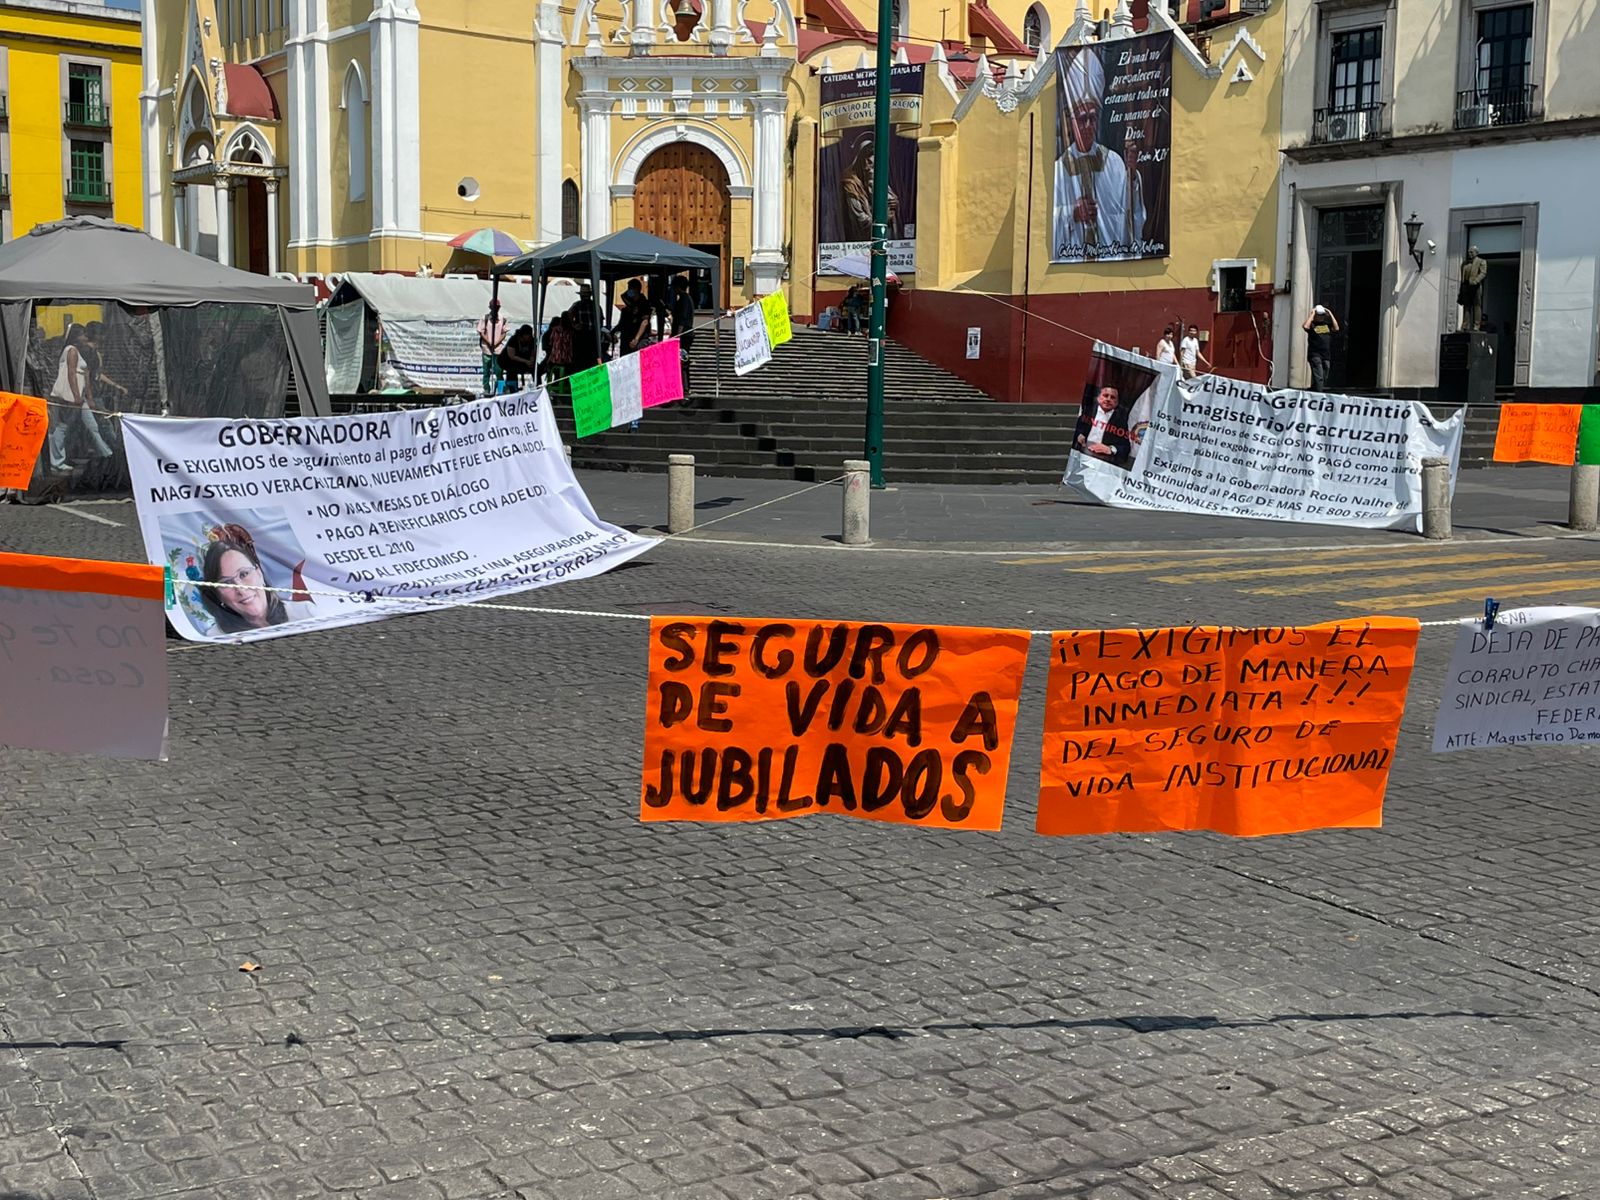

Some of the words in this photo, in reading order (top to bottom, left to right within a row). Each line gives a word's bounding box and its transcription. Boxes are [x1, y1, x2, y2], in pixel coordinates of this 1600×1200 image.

[823, 73, 854, 83] CATEDRAL
[911, 64, 922, 73] DE
[861, 100, 872, 109] DE
[217, 419, 392, 449] GOBERNADORA
[410, 415, 440, 439] Ing
[499, 398, 539, 417] Nalhe
[1156, 409, 1172, 422] Los
[1238, 431, 1251, 440] de
[1271, 393, 1335, 413] García
[1339, 401, 1412, 421] mintió
[183, 455, 266, 475] EXIGIMOS
[268, 453, 289, 468] de
[374, 450, 387, 463] al
[389, 446, 418, 464] pago
[439, 432, 486, 452] nuestro
[1167, 427, 1201, 443] BURLA
[1200, 435, 1219, 446] del
[1296, 452, 1315, 463] NO
[1317, 456, 1353, 470] PAGÓ
[1353, 462, 1390, 474] como
[1193, 447, 1231, 464] público
[1231, 457, 1245, 467] en
[1244, 459, 1257, 470] el
[1321, 472, 1335, 481] el
[1336, 472, 1389, 487] 12/11/24
[150, 480, 260, 503] MAGISTERIO
[371, 457, 459, 487] NUEVAMENTE
[459, 452, 482, 469] FUE
[484, 440, 547, 463] ENGAADO!
[1153, 456, 1203, 479] Exigimos
[1205, 472, 1214, 480] a
[1215, 471, 1227, 483] la
[1309, 489, 1349, 505] Rocío
[1350, 495, 1394, 510] Nalhe
[316, 503, 341, 520] NO
[370, 496, 412, 515] MESAS
[412, 492, 431, 507] DE
[430, 477, 491, 503] DIÁLOGO
[1122, 475, 1219, 511] INSTITUCIONALES
[1208, 486, 1220, 498] al
[1221, 489, 1254, 504] PAGO
[1254, 496, 1275, 508] DE
[1275, 500, 1303, 512] MAS
[1305, 504, 1324, 515] DE
[1325, 508, 1351, 518] 800
[324, 523, 365, 542] PAGO
[368, 522, 380, 537] A
[378, 506, 468, 534] BENEFICIARIOS
[468, 497, 499, 516] CON
[323, 547, 368, 565] DESDE
[367, 544, 386, 559] EL
[385, 540, 416, 555] 2010
[345, 570, 375, 584] NO
[376, 564, 396, 578] AL
[392, 549, 470, 576] FIDECOMISO
[464, 563, 485, 579] DE
[514, 529, 600, 563] ASEGURADORA.
[659, 619, 941, 685] SEGURO
[1326, 621, 1375, 649] EL
[1470, 629, 1534, 655] DEJA
[1543, 627, 1569, 651] DE
[1070, 668, 1164, 700] PAGO
[1181, 661, 1222, 685] DE
[1239, 655, 1390, 685] MANERA
[1457, 663, 1561, 685] CORRUPTO
[658, 680, 742, 733] DE
[785, 677, 923, 748] VIDA
[949, 690, 999, 752] A
[1083, 689, 1284, 728] INMEDIATA
[1454, 688, 1537, 711] SINDICAL,
[1062, 736, 1125, 765] DEL
[1144, 724, 1274, 754] SEGURO
[1294, 718, 1342, 740] DE
[1486, 727, 1565, 746] Magisterio
[644, 742, 993, 822] JUBILADOS
[1065, 771, 1136, 799] VIDA
[1161, 747, 1391, 793] INSTITUCIONAL
